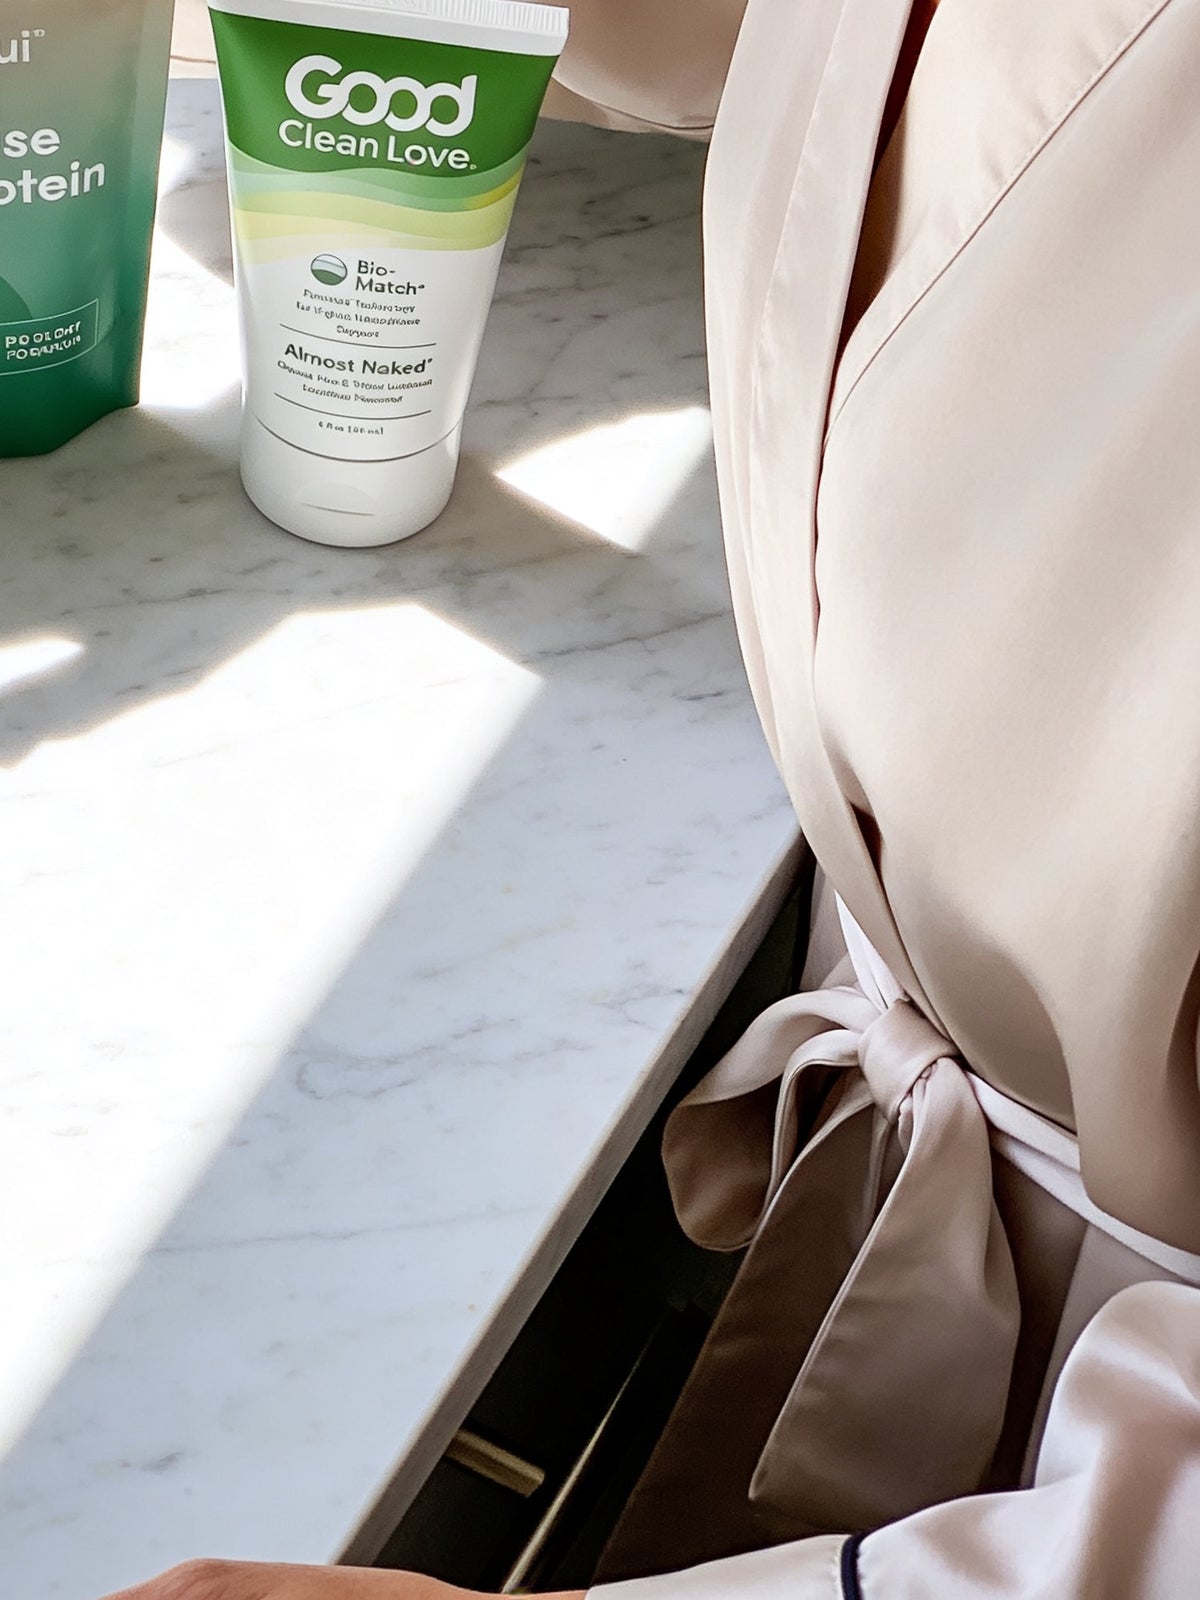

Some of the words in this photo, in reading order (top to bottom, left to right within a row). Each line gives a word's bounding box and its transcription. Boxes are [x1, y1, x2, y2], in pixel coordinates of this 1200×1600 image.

[284, 54, 478, 138] Good
[278, 118, 379, 158] Clean
[357, 259, 397, 277] Bio-
[284, 343, 355, 373] Almost
